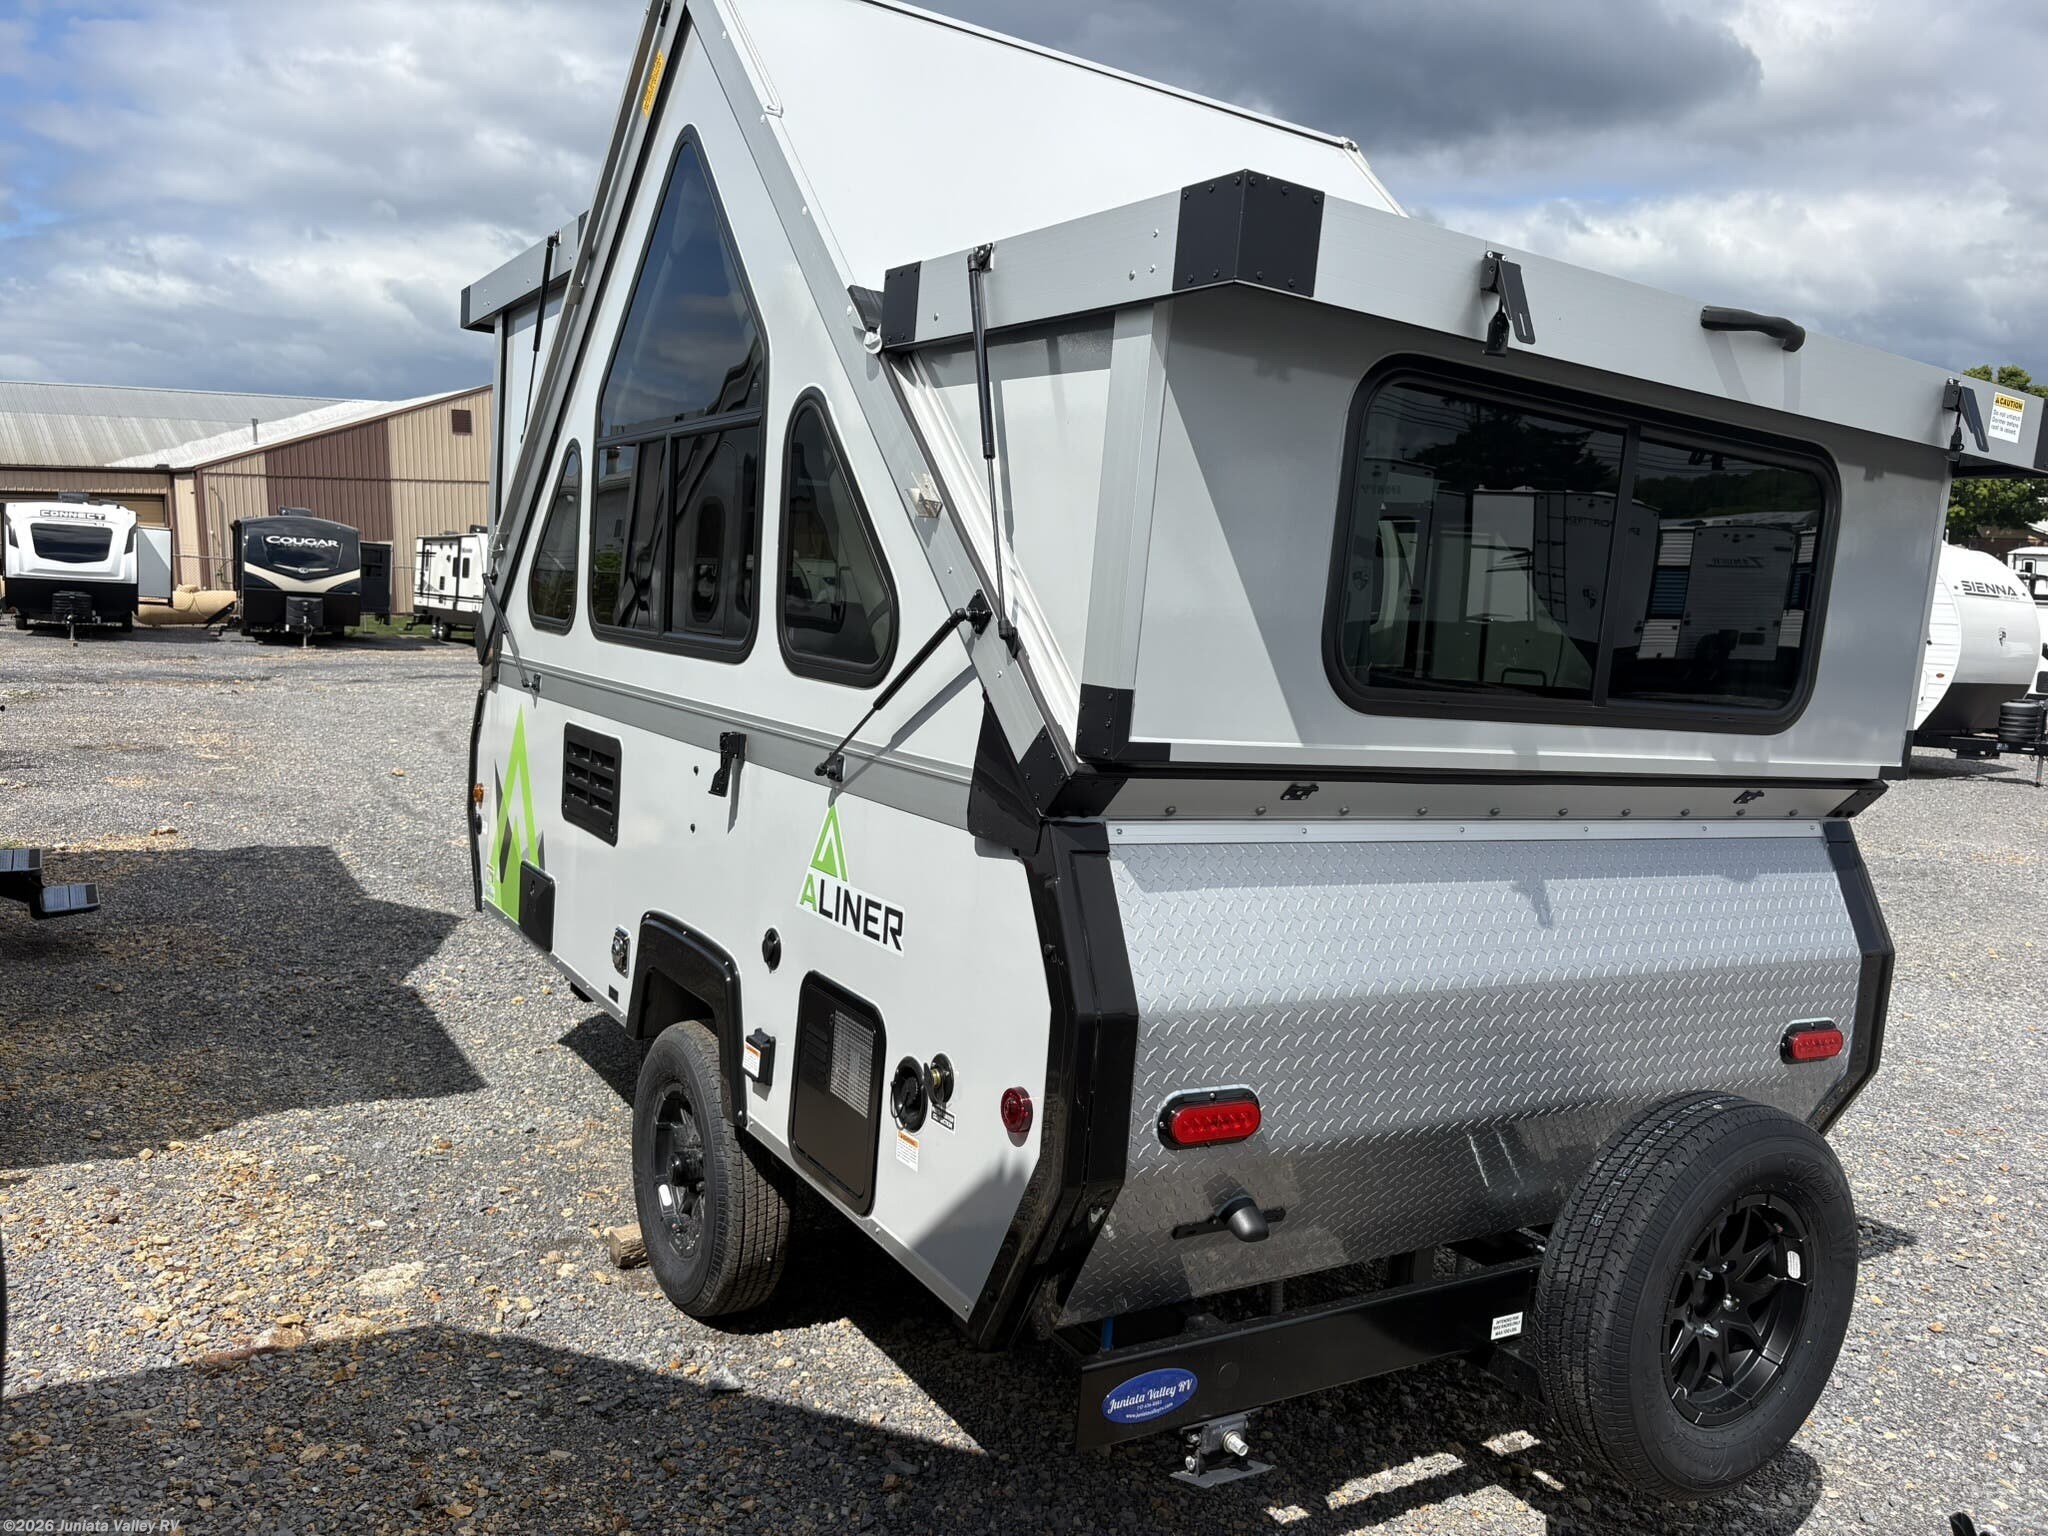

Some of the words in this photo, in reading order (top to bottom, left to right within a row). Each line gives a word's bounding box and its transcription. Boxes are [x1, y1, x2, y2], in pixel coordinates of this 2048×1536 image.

[1999, 397, 2023, 410] CAUTION
[40, 510, 105, 520] CONNECT
[266, 535, 338, 548] COUGAR
[1960, 580, 2018, 596] SIENNA
[799, 873, 904, 952] ALINER
[1107, 1394, 1145, 1415] Juniata
[1147, 1385, 1177, 1399] Valley
[1178, 1379, 1193, 1393] RV
